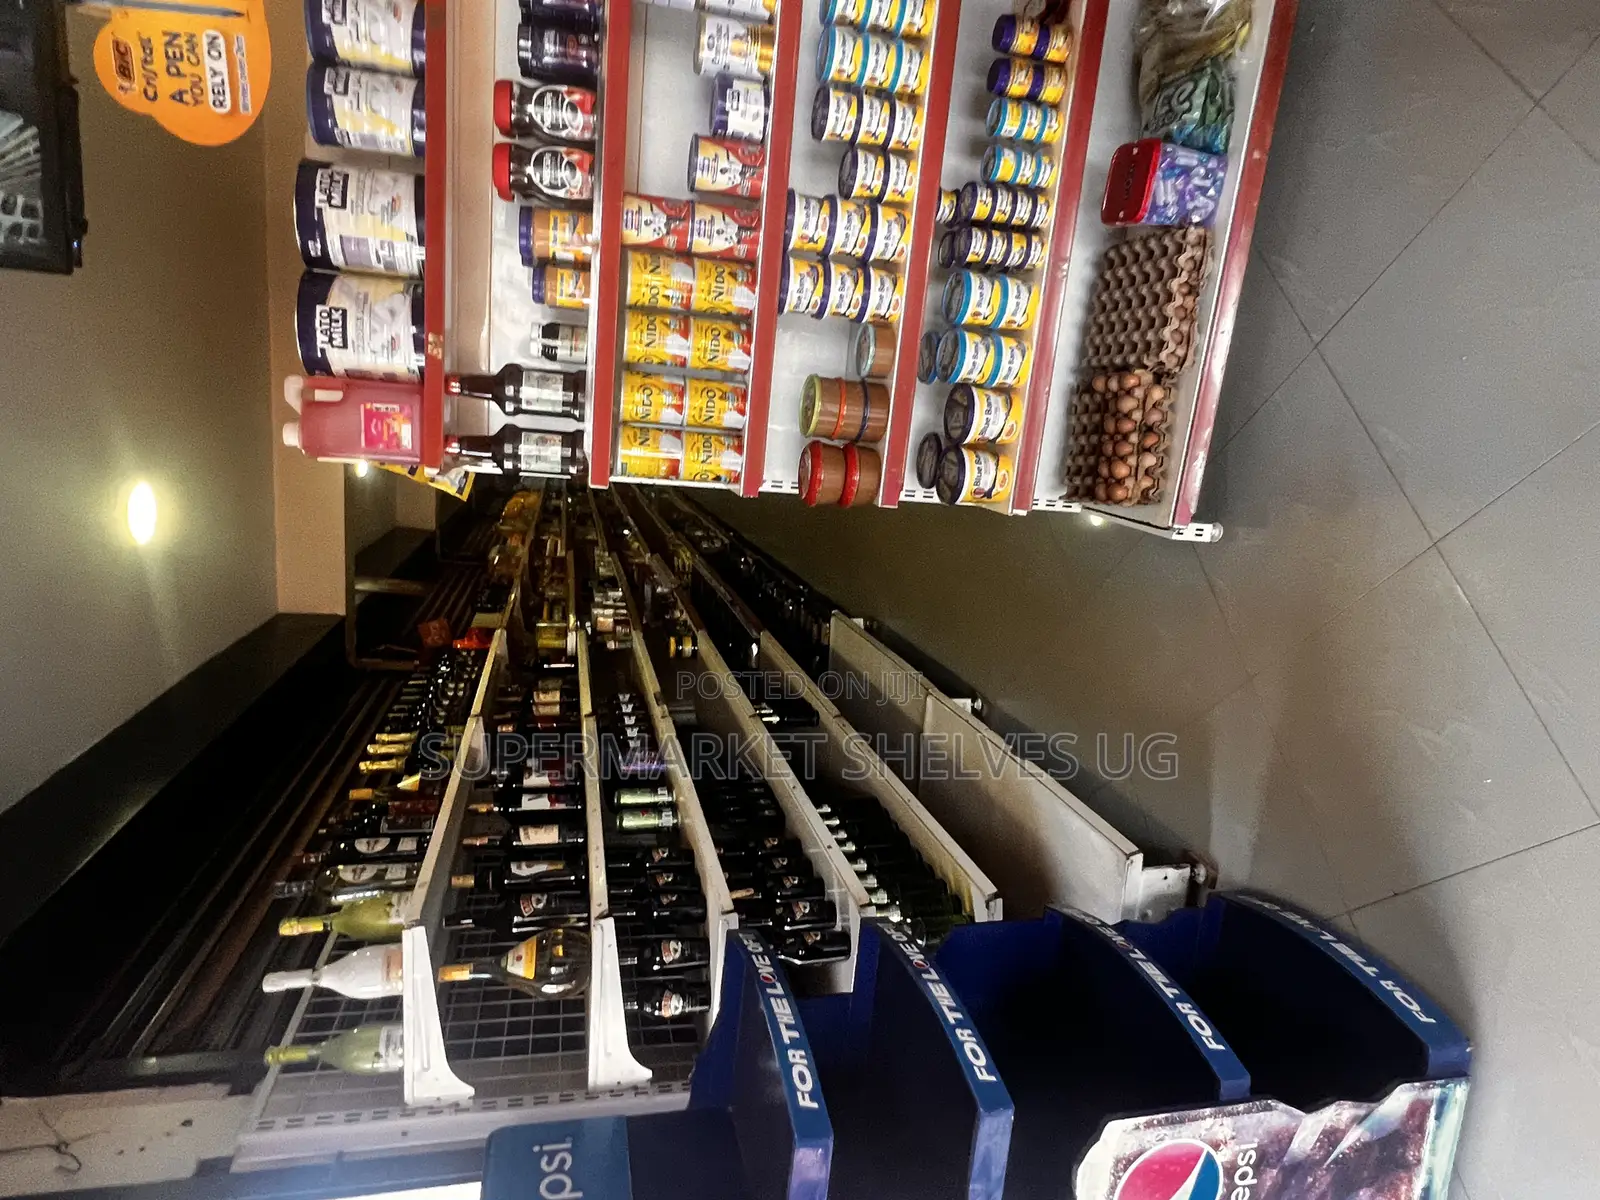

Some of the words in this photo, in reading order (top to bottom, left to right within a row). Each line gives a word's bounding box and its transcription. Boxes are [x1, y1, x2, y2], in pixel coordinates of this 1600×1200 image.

[161, 30, 187, 78] PEN
[185, 32, 201, 67] CAN
[204, 34, 222, 61] ON
[168, 89, 190, 106] A
[189, 72, 204, 107] YOU
[209, 66, 227, 110] RELY
[711, 265, 725, 301] NIDO
[319, 309, 330, 345] LATO
[706, 327, 721, 363] NIDO
[638, 388, 653, 421] NIDO
[702, 388, 717, 423] NIDO
[978, 417, 989, 436] Blue
[973, 466, 982, 486] Blue
[751, 954, 784, 995] LOVE
[899, 943, 940, 981] LOVE
[1328, 942, 1380, 977] THE
[1136, 960, 1180, 999] THE
[769, 997, 800, 1044] THE
[926, 982, 964, 1025] THE
[1378, 979, 1438, 1024] FOR
[1175, 1002, 1226, 1050] FOR
[954, 1027, 997, 1082] FOR
[786, 1049, 819, 1109] FOR
[532, 1142, 584, 1199] psi
[1231, 1142, 1259, 1200] epsi
